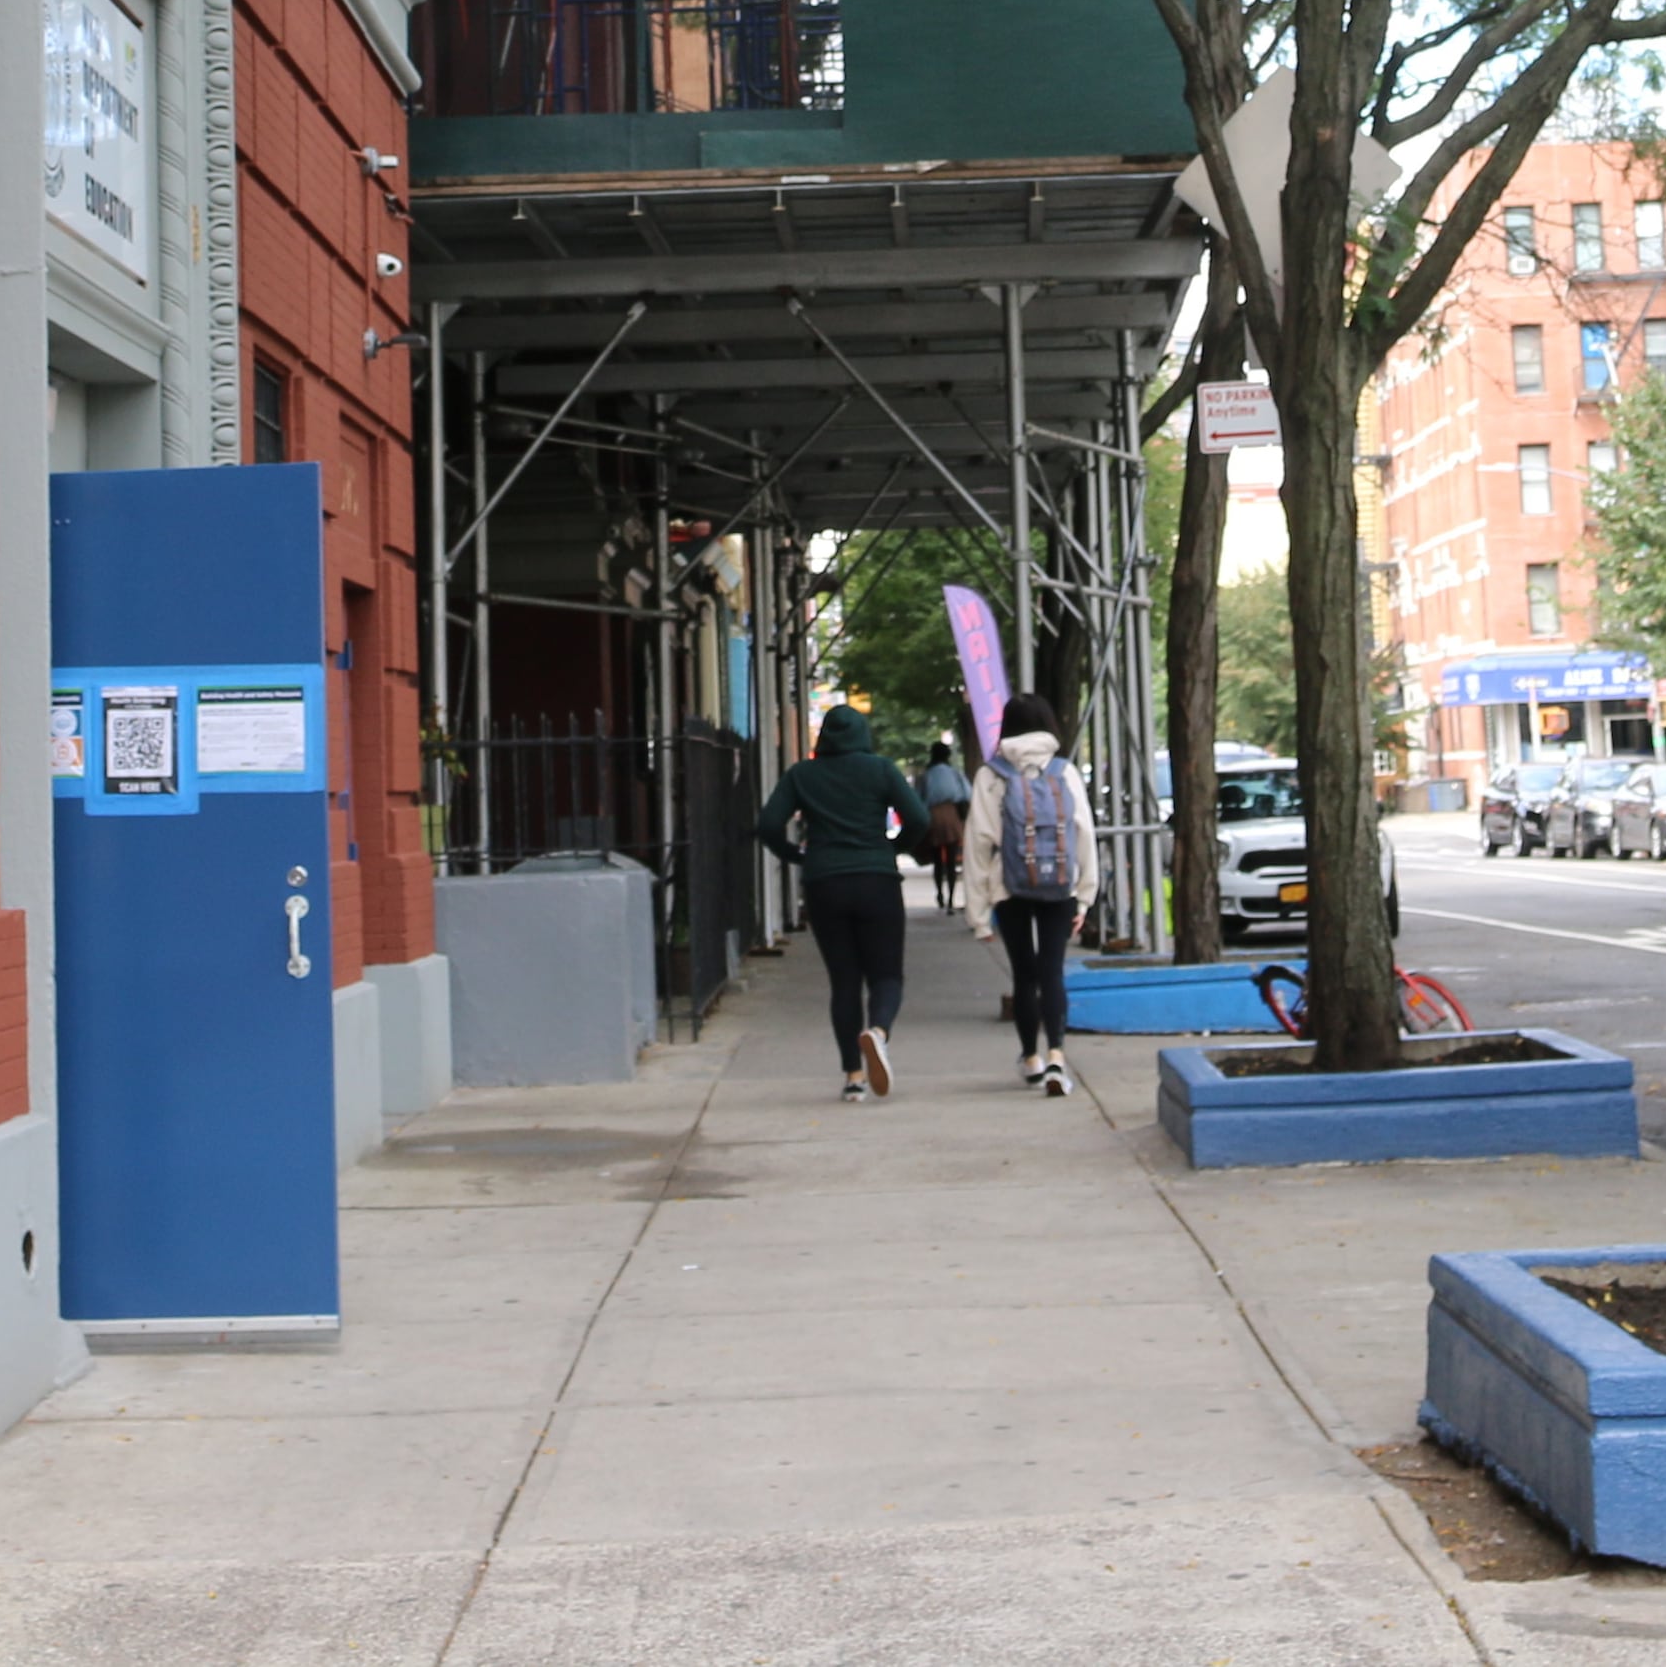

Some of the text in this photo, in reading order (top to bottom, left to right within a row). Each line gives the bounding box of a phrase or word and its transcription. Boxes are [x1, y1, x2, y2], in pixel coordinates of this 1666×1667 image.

[83, 61, 138, 142] DEPARTMENT
[85, 173, 133, 242] EDUCATION
[1205, 388, 1271, 403] NO PARKIN
[1207, 405, 1257, 420] Anytime
[119, 781, 161, 793] SCAN HERE
